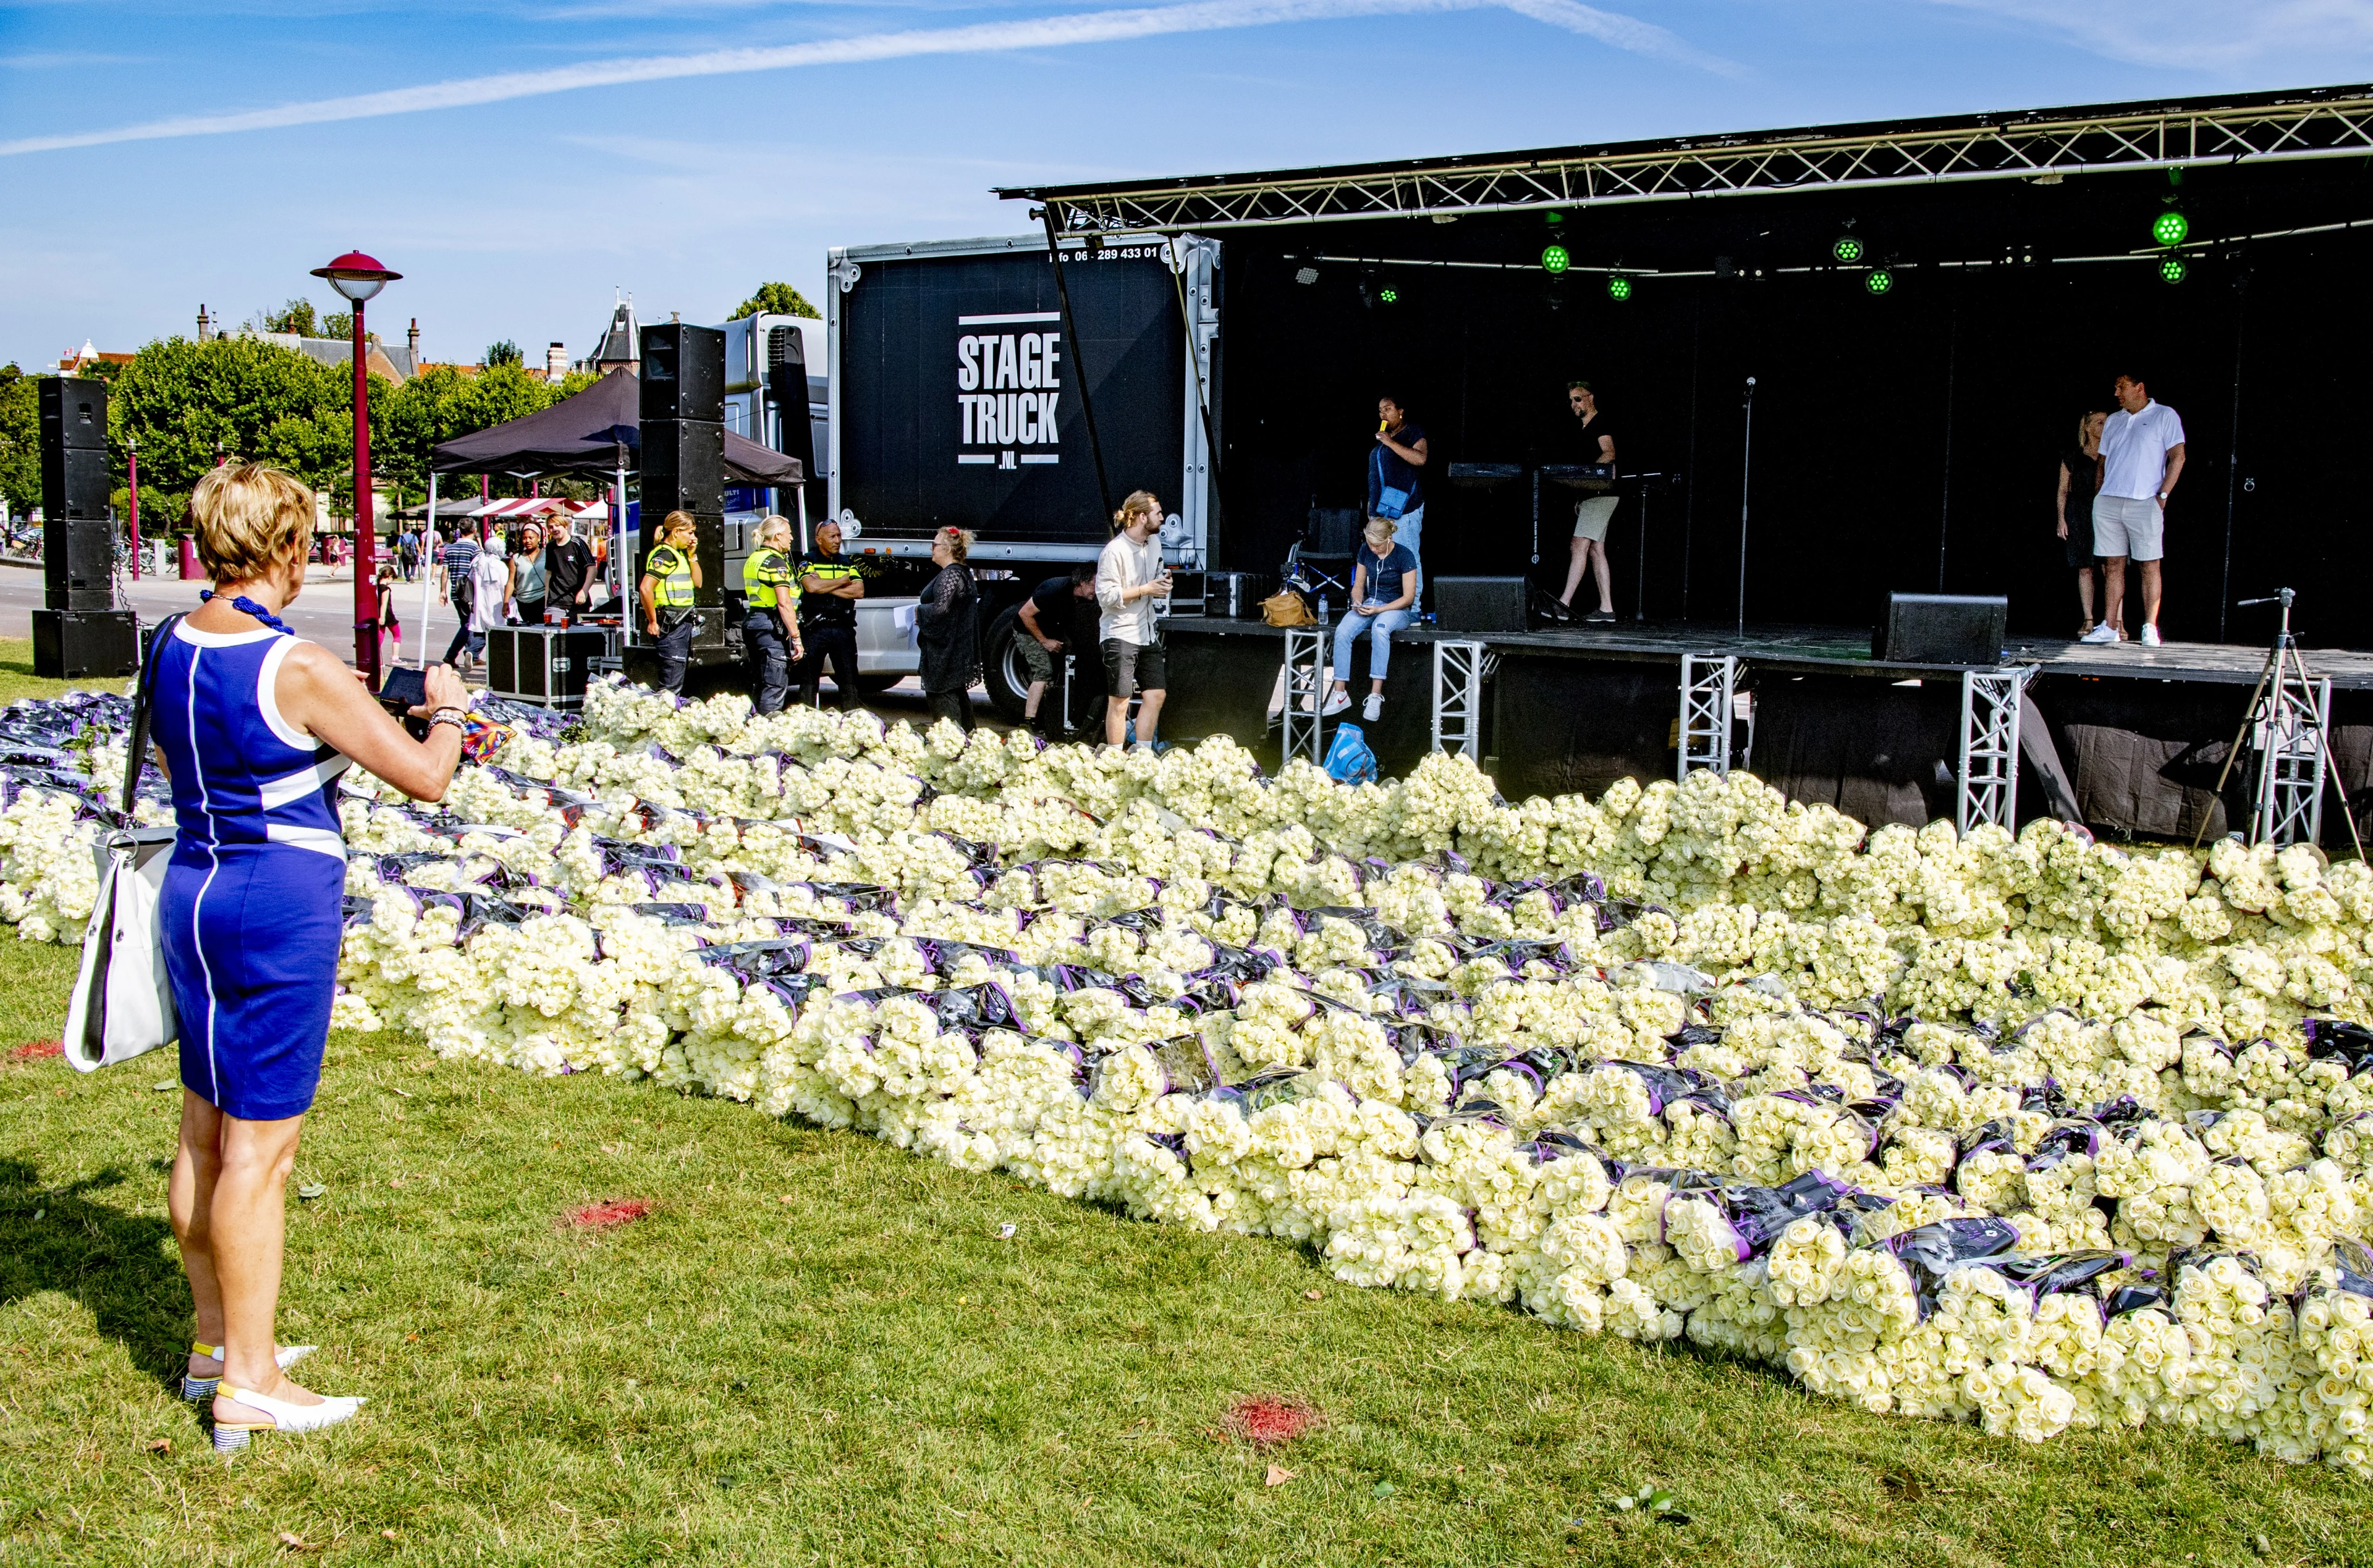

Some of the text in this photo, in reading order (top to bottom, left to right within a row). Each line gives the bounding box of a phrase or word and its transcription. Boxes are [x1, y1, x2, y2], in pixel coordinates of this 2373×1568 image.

[1049, 253, 1069, 263] ifo
[1075, 251, 1088, 261] 06
[1098, 249, 1118, 260] 289
[1120, 248, 1141, 259] 433
[1144, 247, 1157, 258] 01
[958, 332, 1060, 390] STAGE
[958, 392, 1059, 445] TRUCK
[999, 451, 1017, 470] .NL
